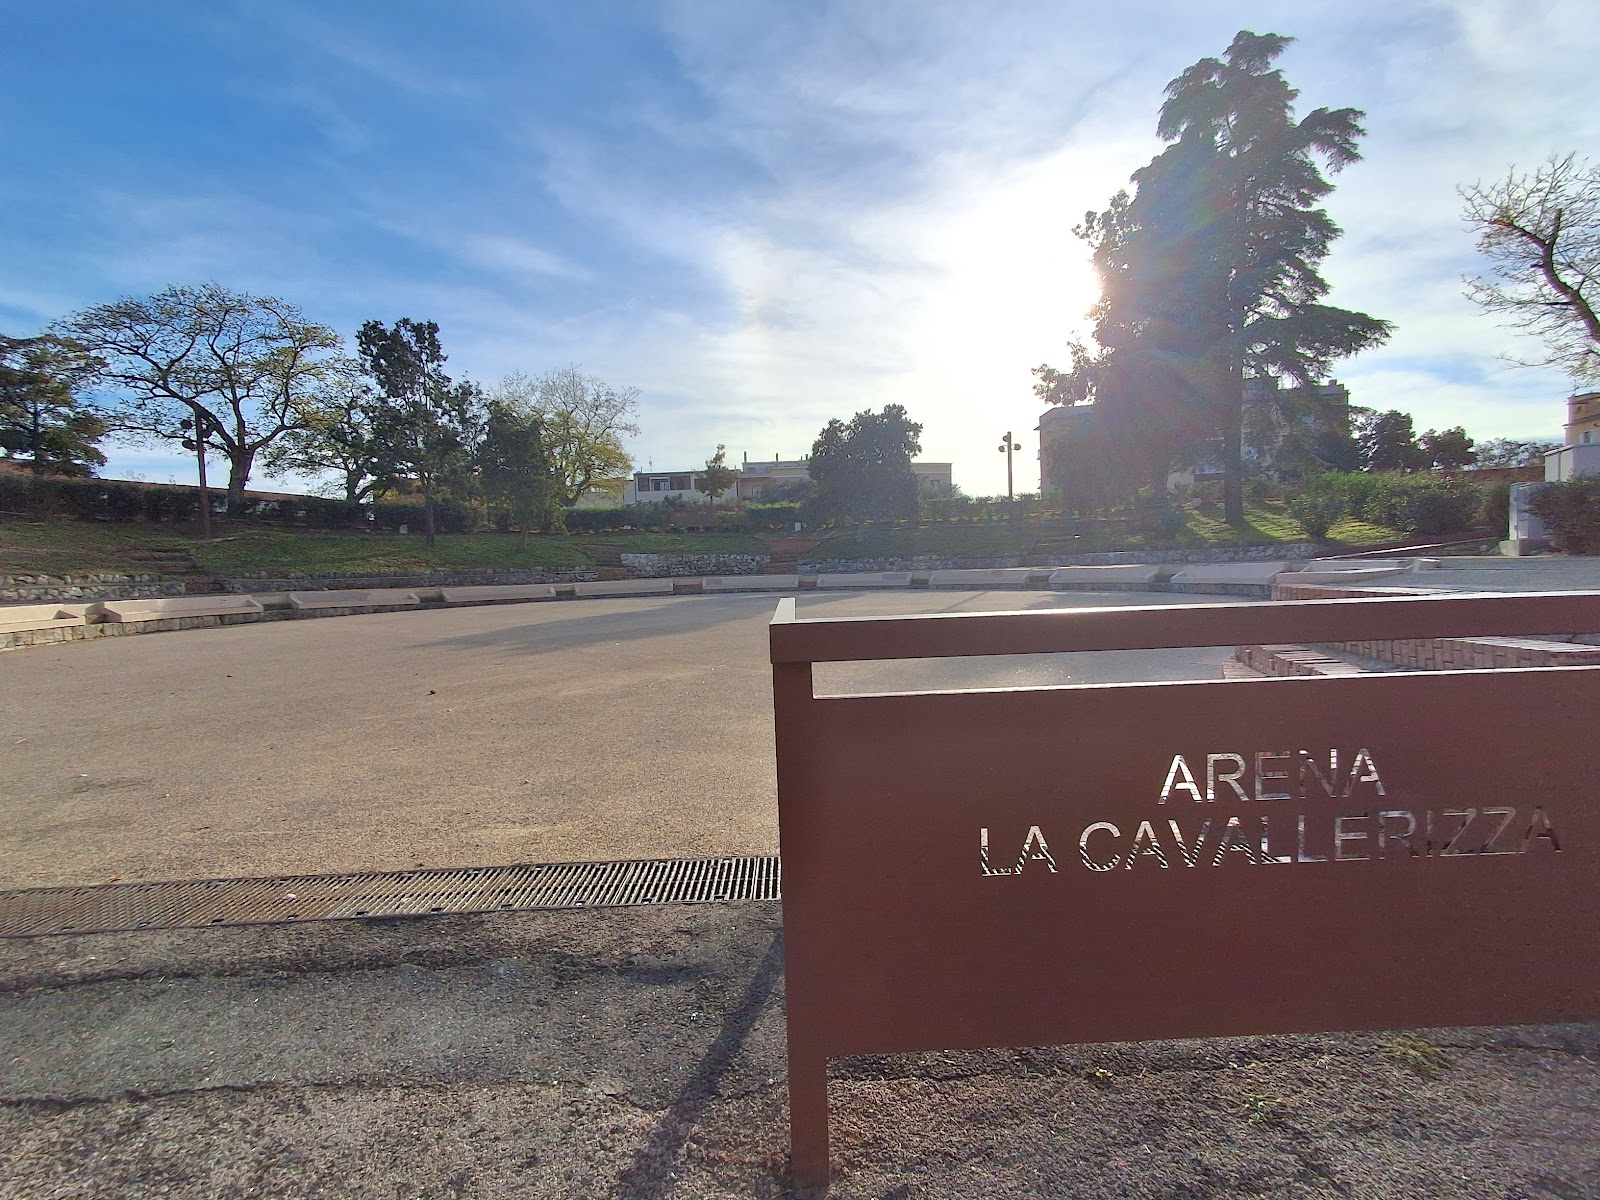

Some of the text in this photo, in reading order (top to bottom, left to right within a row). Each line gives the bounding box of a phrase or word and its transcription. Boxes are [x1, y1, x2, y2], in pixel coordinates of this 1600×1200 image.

[1158, 748, 1386, 805] ARENA
[979, 805, 1563, 877] LA CAVALLERIZZA
